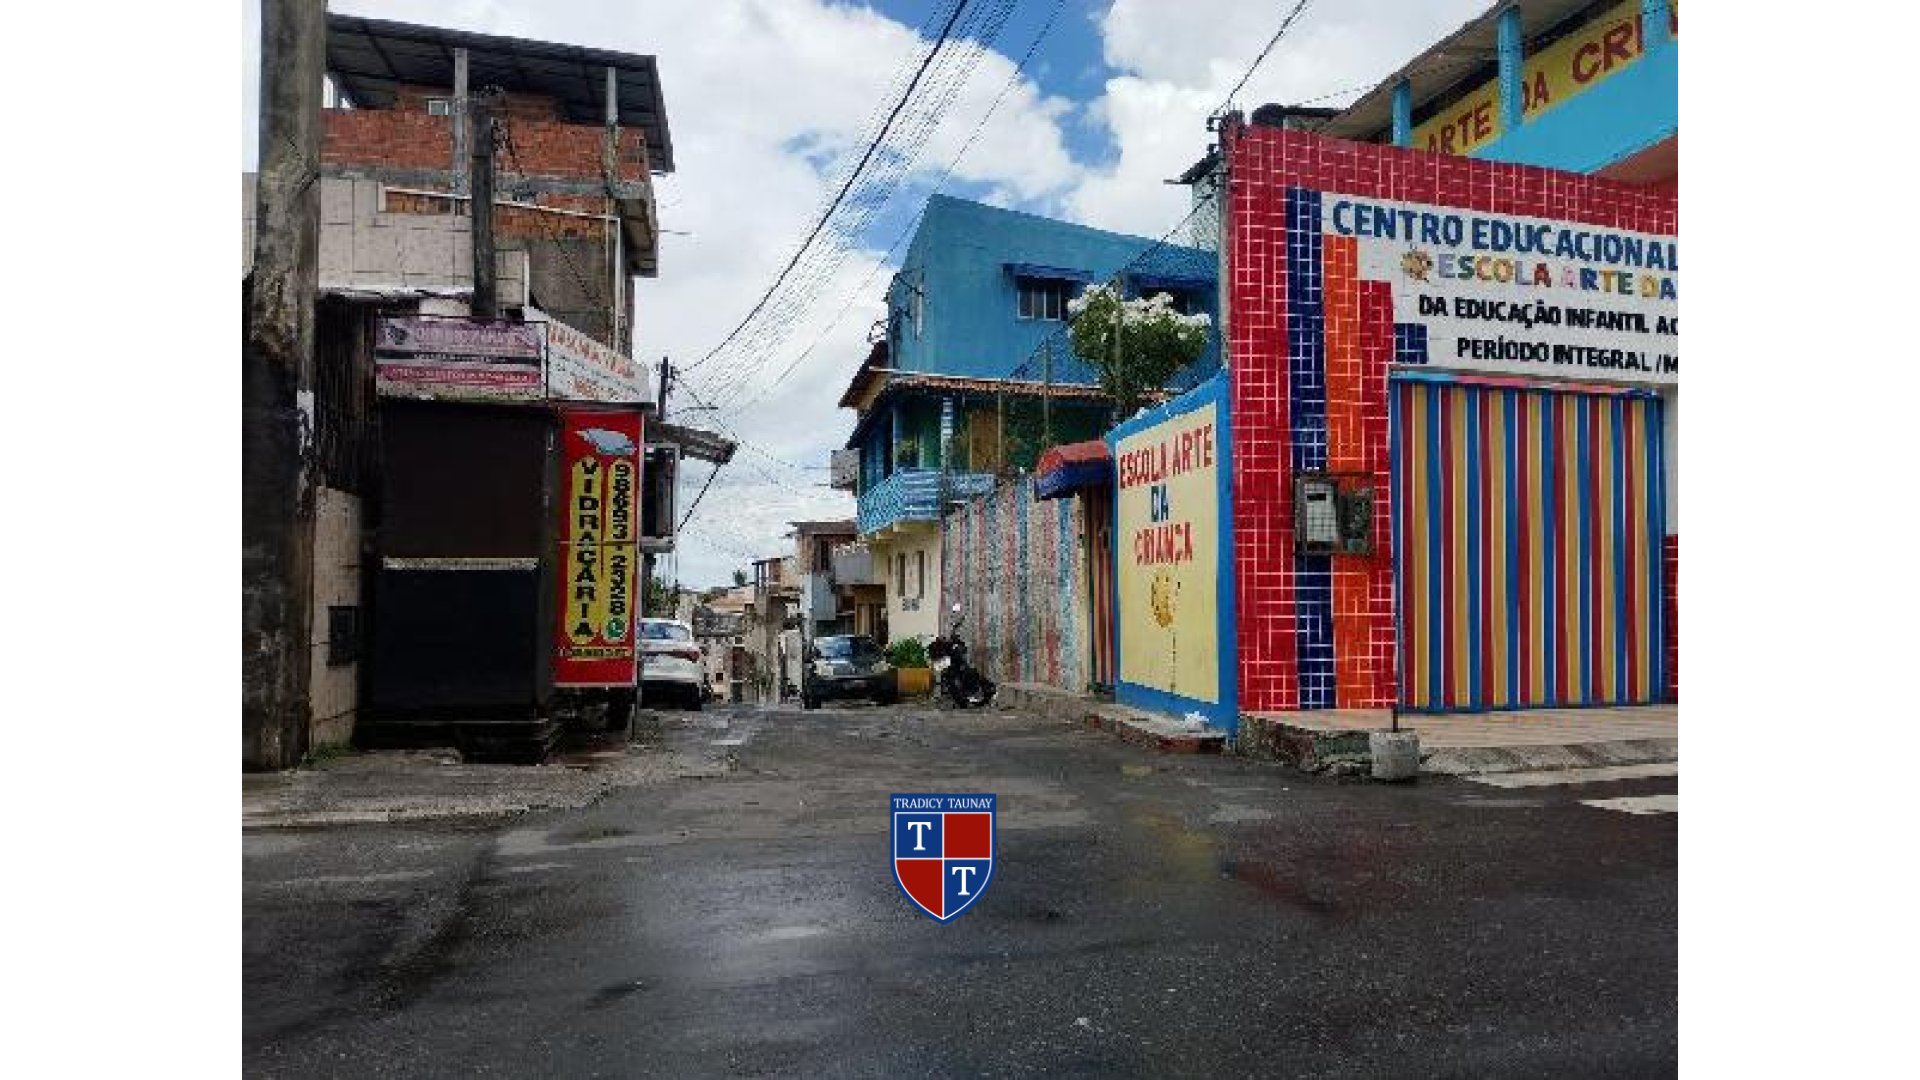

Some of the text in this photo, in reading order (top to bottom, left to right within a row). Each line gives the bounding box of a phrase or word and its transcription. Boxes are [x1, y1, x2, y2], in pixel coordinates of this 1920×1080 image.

[1427, 100, 1492, 155] ARTE
[1332, 201, 1678, 272] CENTRO EDUCACIONAL
[1438, 254, 1677, 300] ESCOLA ARTE DA
[1418, 294, 1449, 317] DA
[1455, 297, 1562, 329] EDUCAÇÃO
[1566, 308, 1650, 334] INFANTIL
[1457, 336, 1550, 363] PERÍODO
[1554, 344, 1650, 372] INTEGRAL
[1119, 424, 1213, 489] ESCOLA ARTE
[1150, 485, 1169, 522] DA
